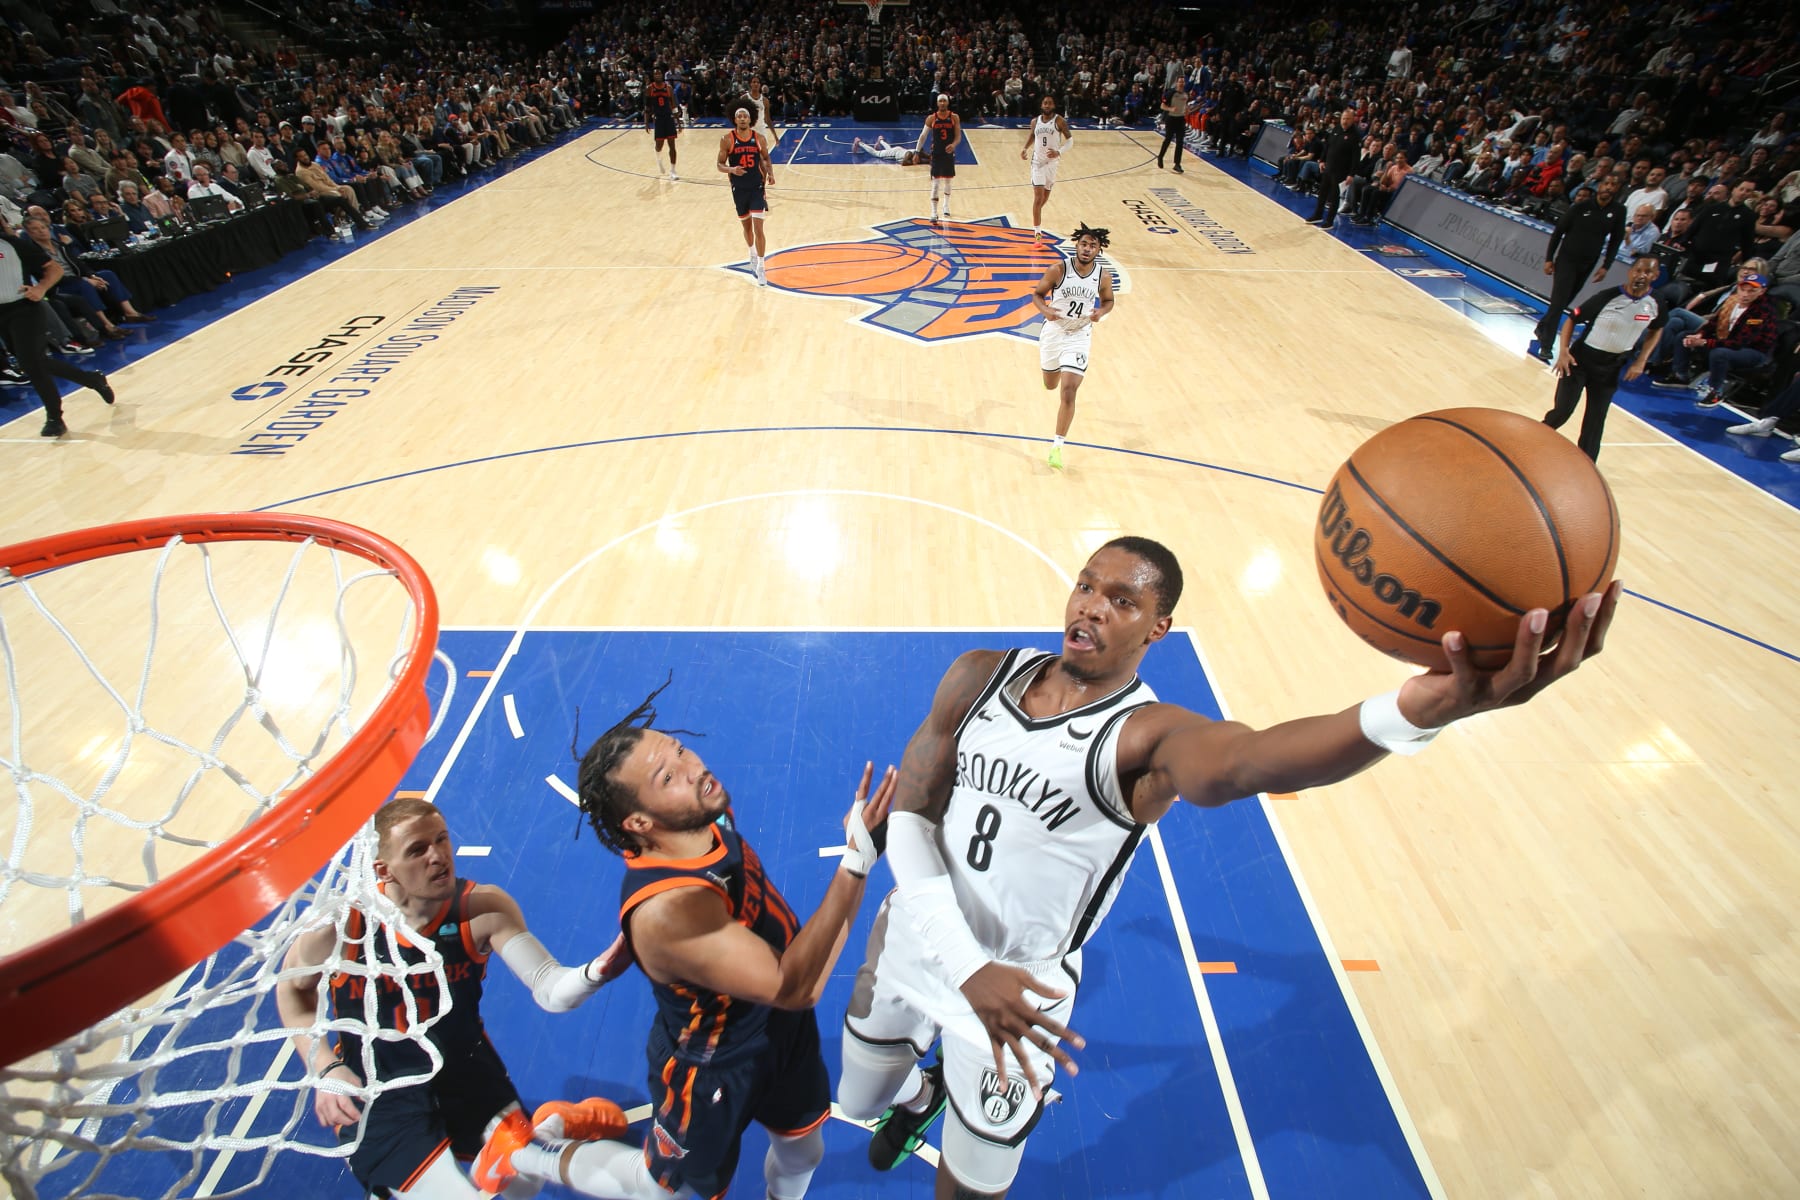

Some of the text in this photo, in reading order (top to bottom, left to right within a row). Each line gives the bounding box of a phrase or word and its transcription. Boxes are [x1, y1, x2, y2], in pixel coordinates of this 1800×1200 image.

[939, 129, 948, 140] 3
[1042, 137, 1047, 147] 9
[739, 154, 755, 168] 45
[1121, 199, 1170, 226] CHASE
[1066, 301, 1084, 318] 24
[265, 315, 386, 377] CHASE
[230, 286, 501, 455] MADISON SQUARE GARDEN
[1320, 480, 1442, 630] Wilson
[1059, 740, 1084, 753] Webull
[966, 803, 1001, 872] 8
